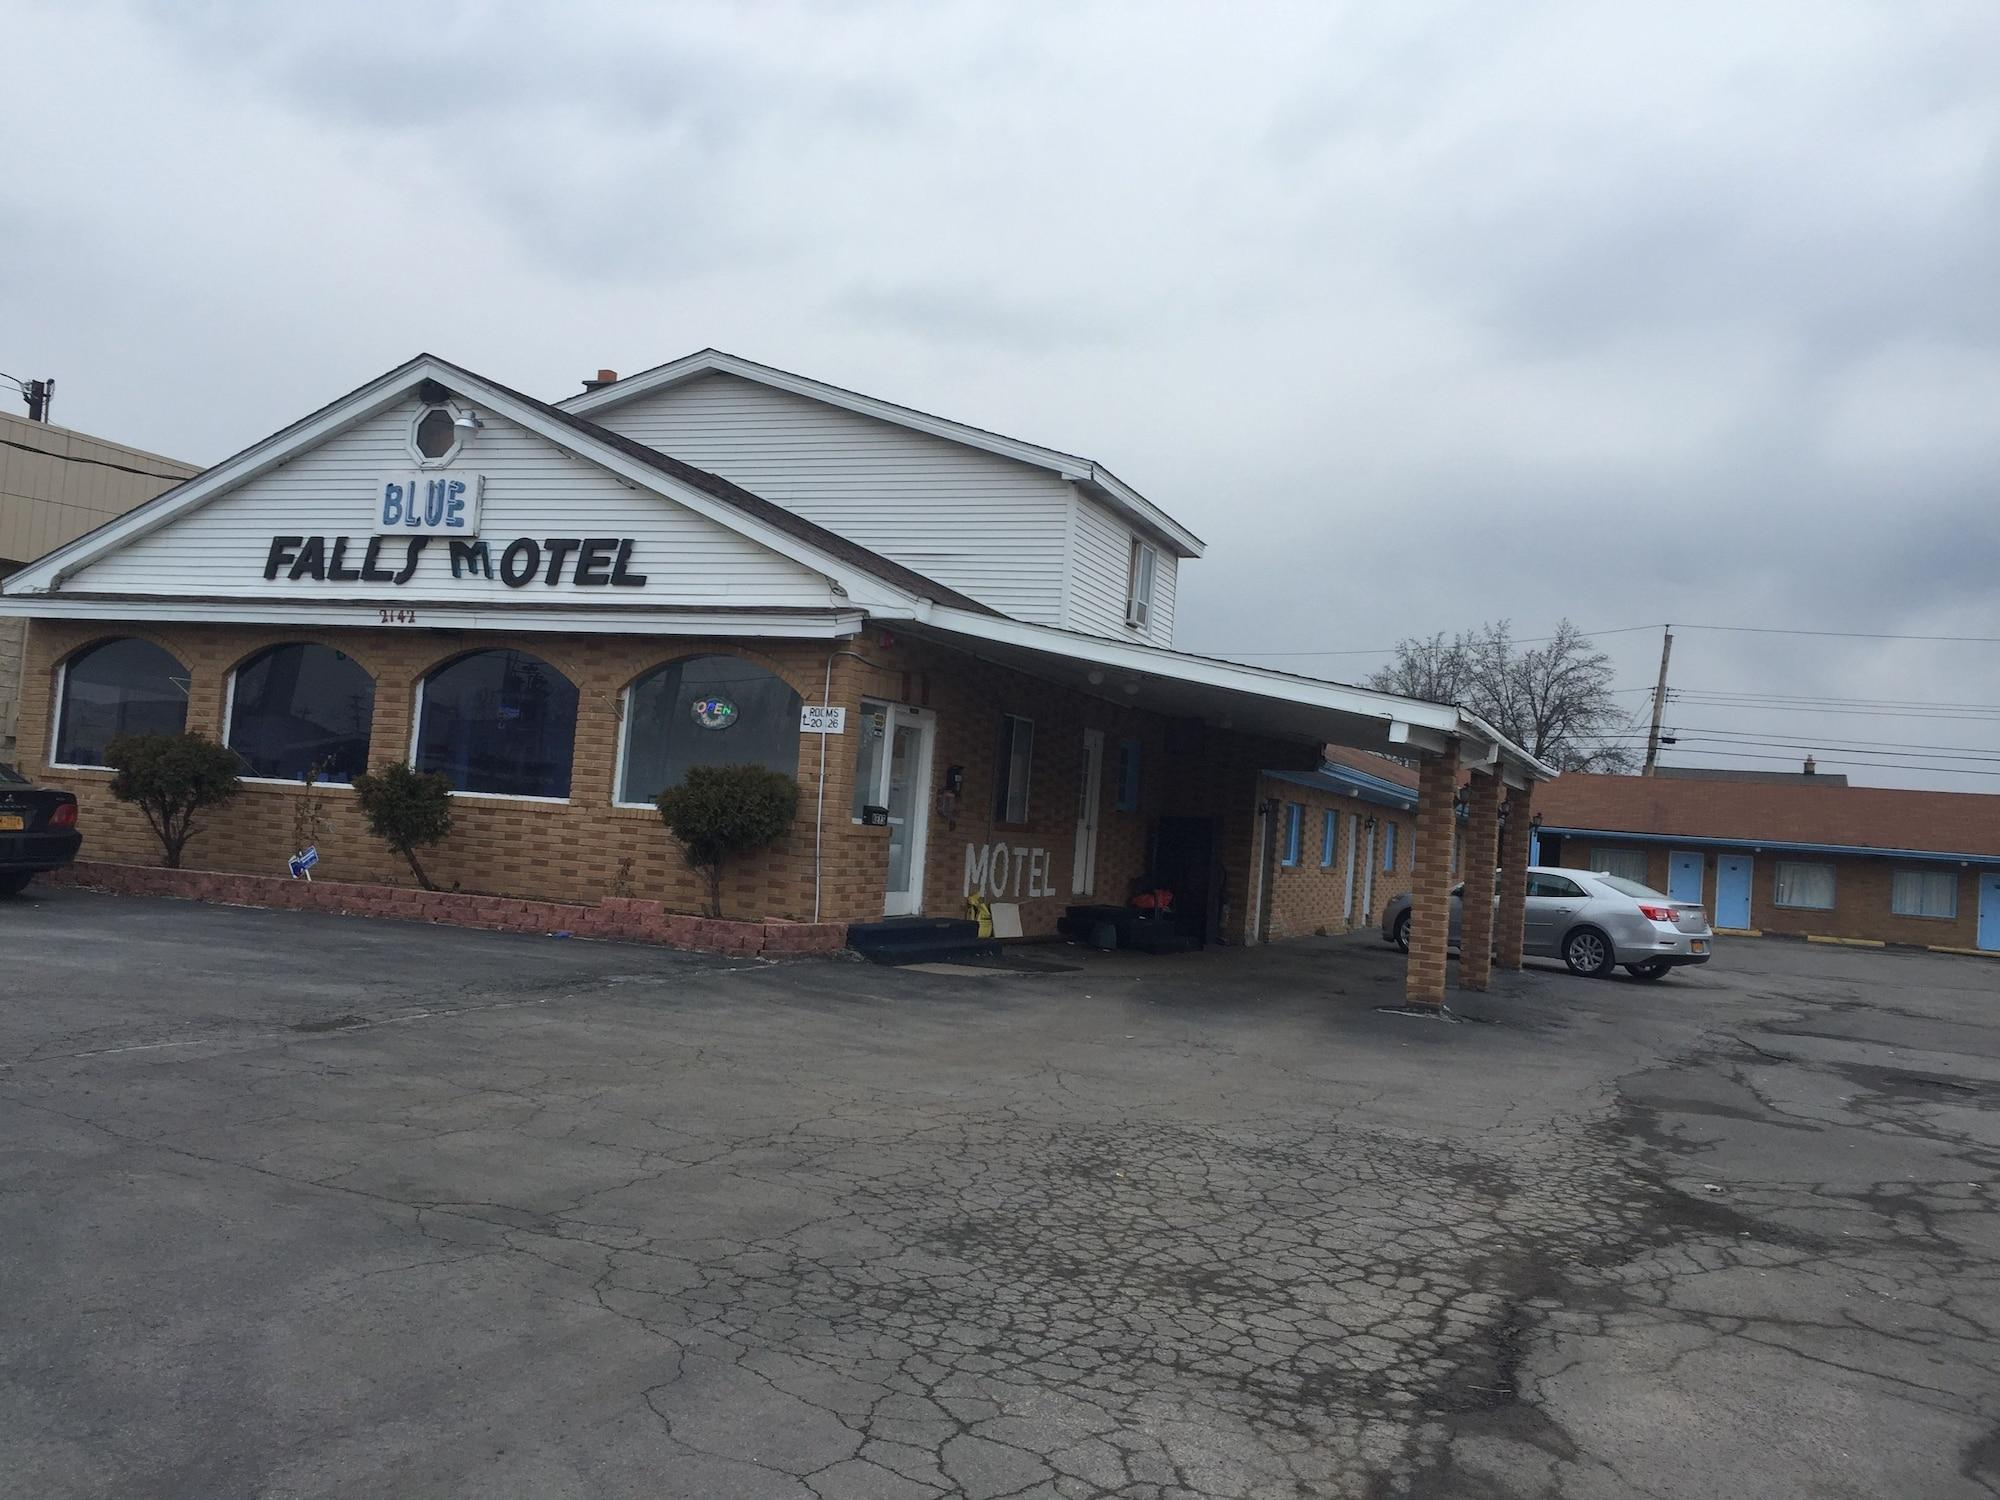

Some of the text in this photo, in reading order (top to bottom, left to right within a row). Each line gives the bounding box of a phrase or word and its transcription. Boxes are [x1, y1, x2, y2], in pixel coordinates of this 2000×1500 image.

[382, 478, 466, 528] BLUE
[263, 535, 648, 588] FALLS MOTEL
[380, 609, 415, 623] 2142
[963, 842, 1056, 898] MOTEL
